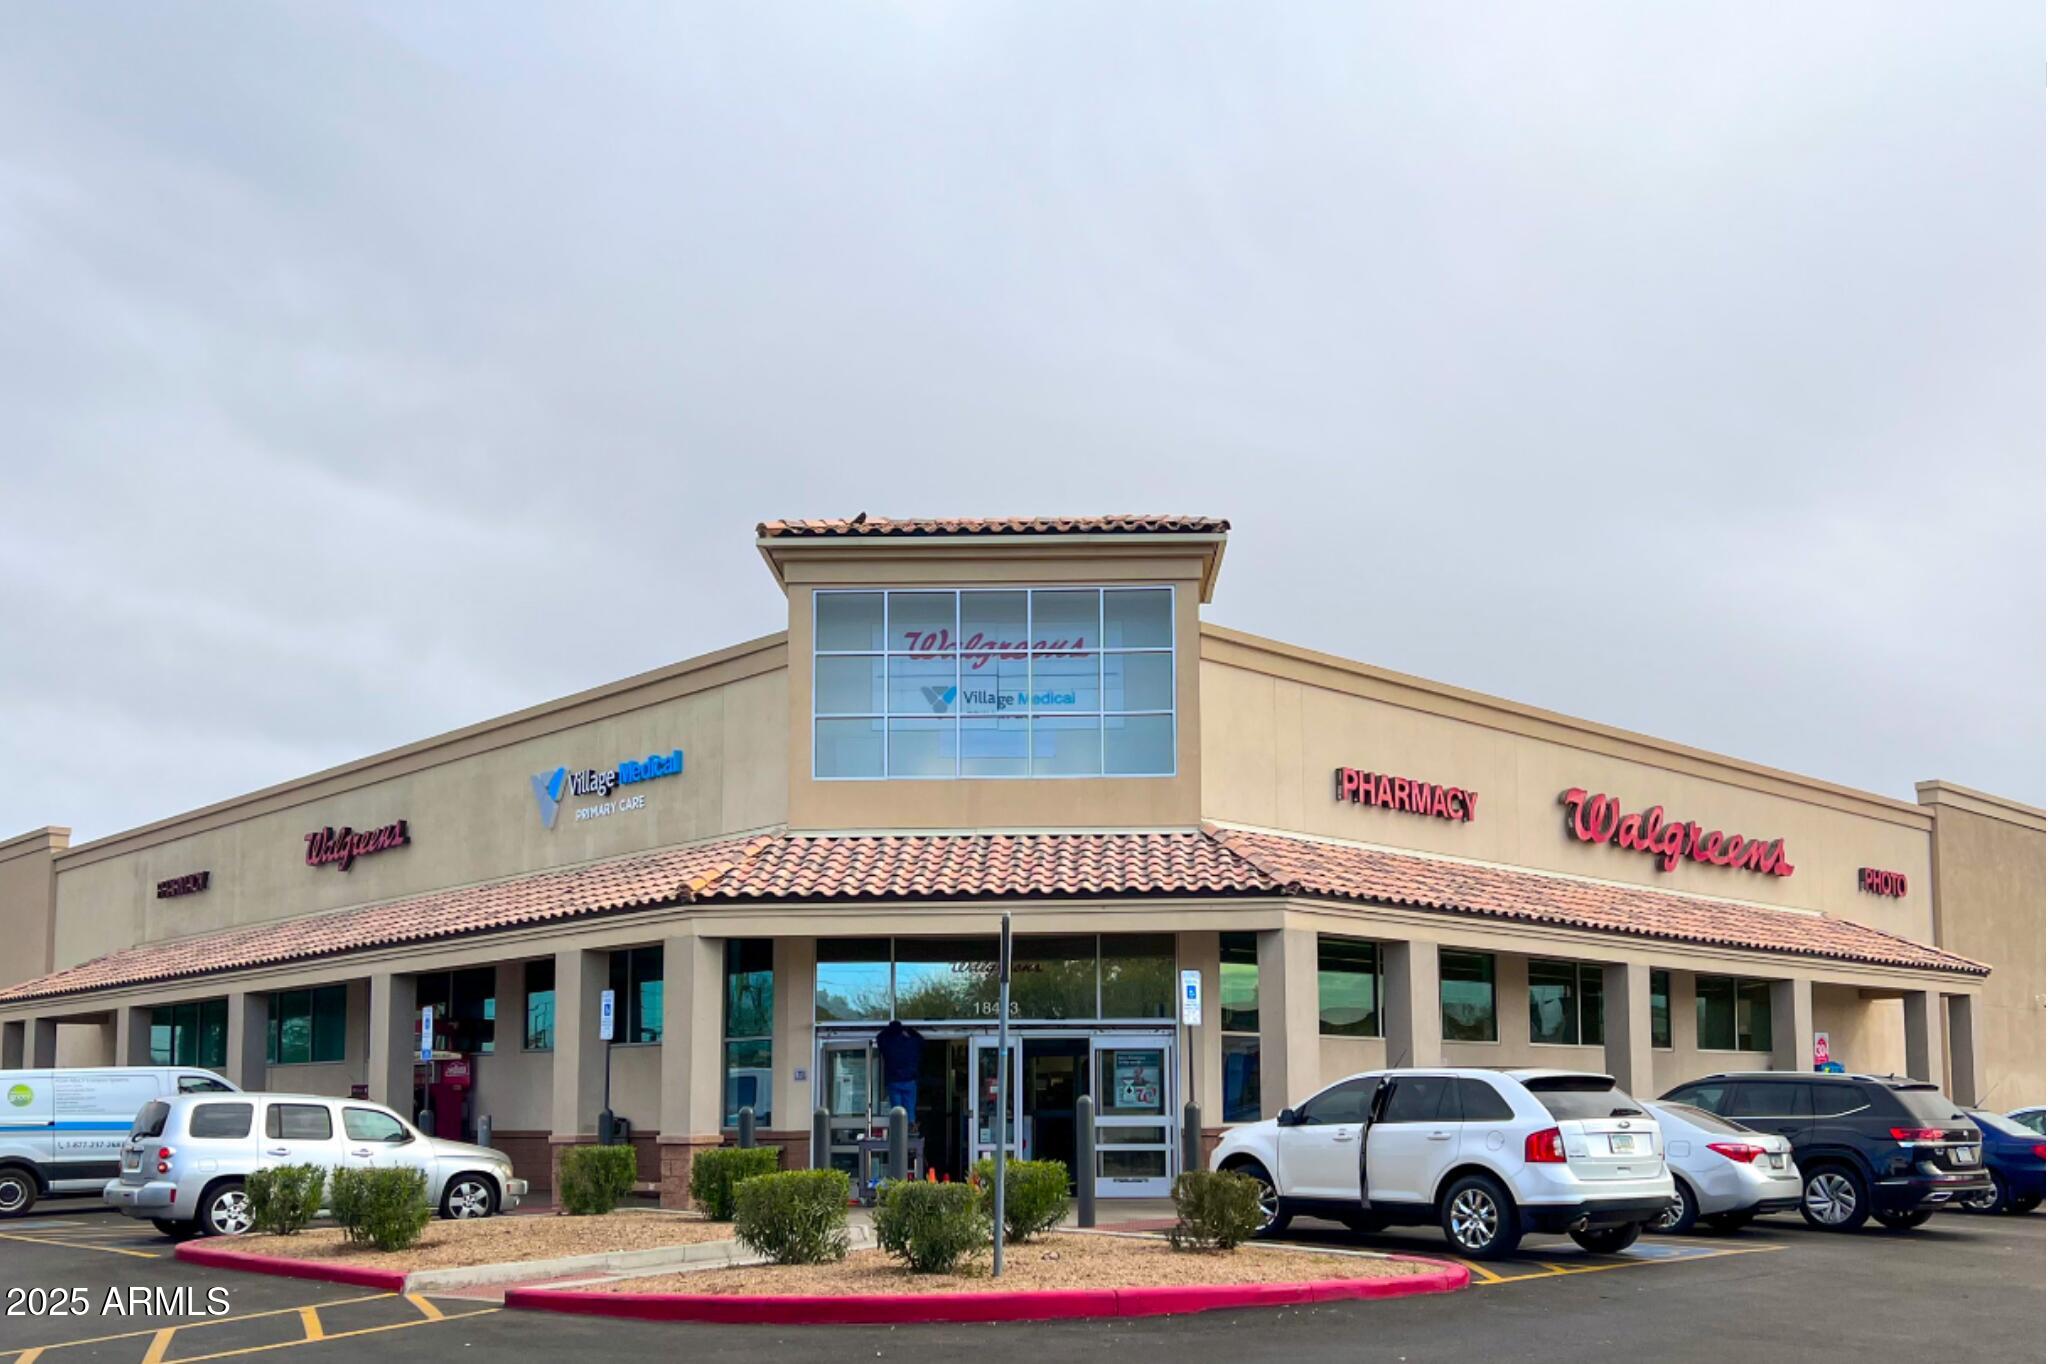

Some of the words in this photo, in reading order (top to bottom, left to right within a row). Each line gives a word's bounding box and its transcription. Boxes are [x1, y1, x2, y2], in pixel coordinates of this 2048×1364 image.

[905, 629, 1090, 670] Walgreens
[963, 690, 1014, 710] Village
[1018, 689, 1076, 705] Medical
[568, 769, 617, 797] Village
[618, 750, 684, 785] Medical
[575, 802, 616, 821] PRIMARY
[619, 795, 646, 812] CARE
[1338, 767, 1478, 822] PHARMACY
[304, 820, 410, 872] Walgreens
[1558, 787, 1795, 876] Walgreens
[1860, 868, 1908, 898] PHOTO
[973, 1001, 1019, 1015] 1843
